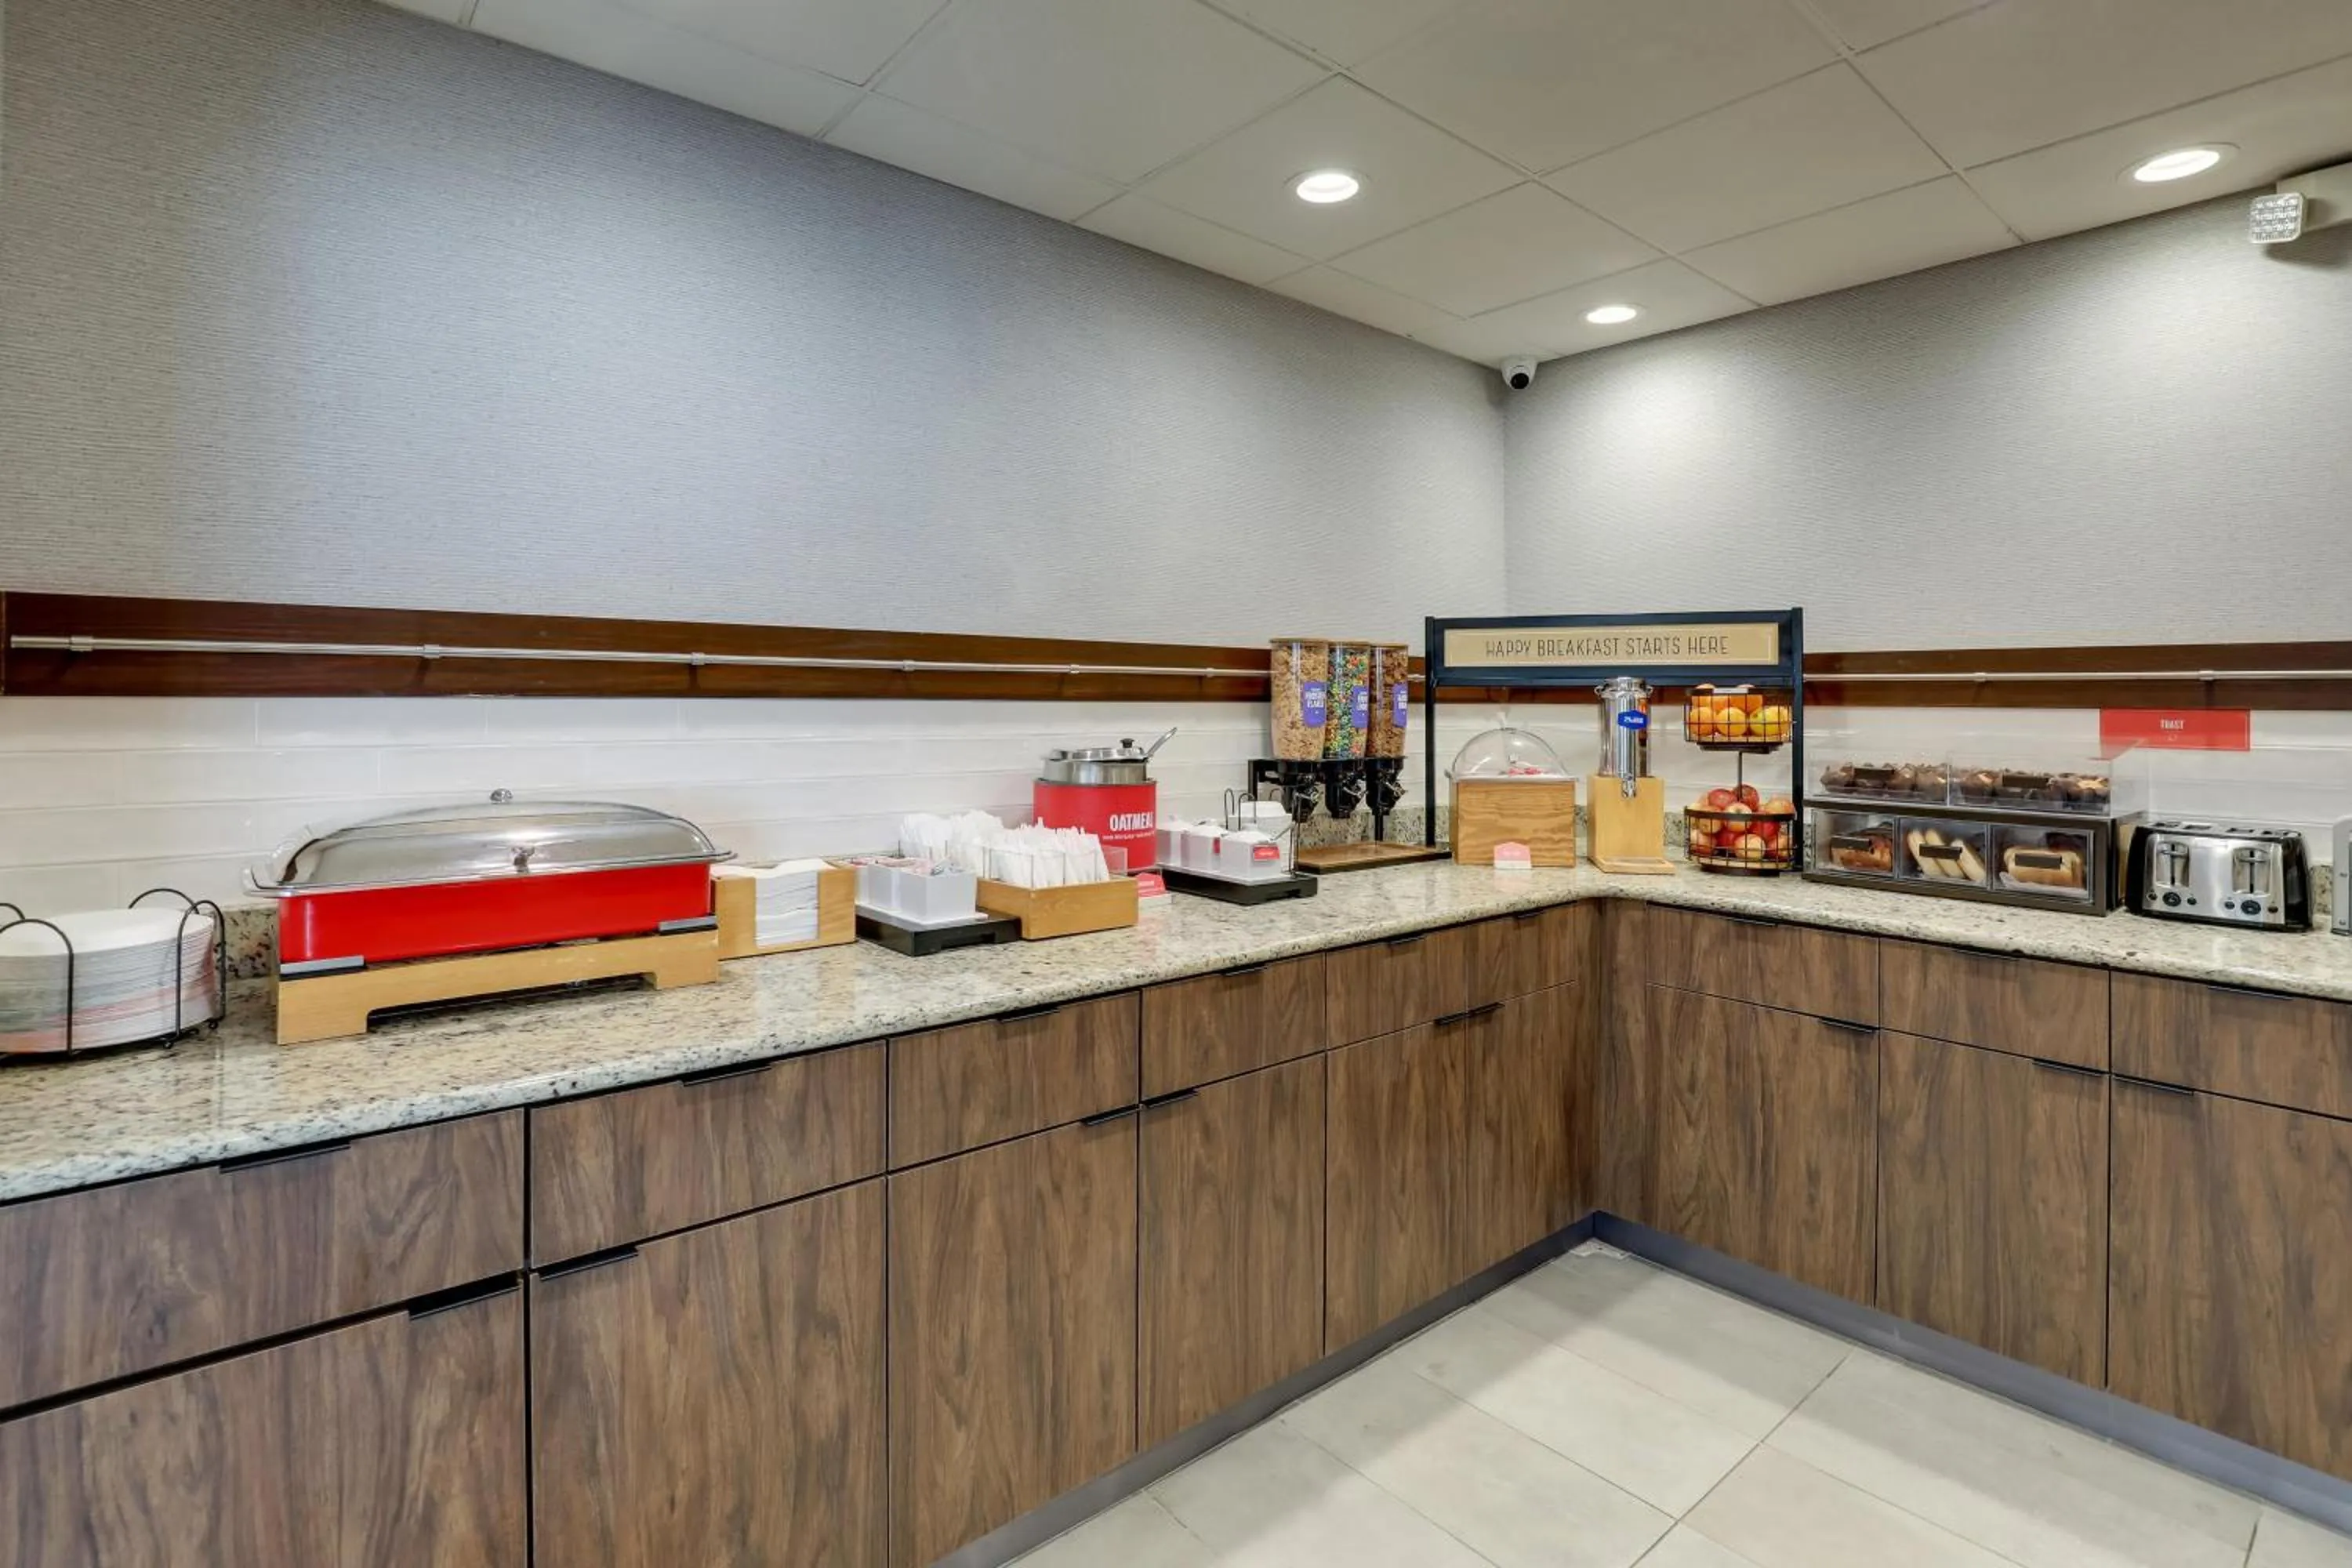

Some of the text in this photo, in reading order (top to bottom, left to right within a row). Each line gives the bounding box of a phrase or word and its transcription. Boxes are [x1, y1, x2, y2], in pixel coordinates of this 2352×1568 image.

[1486, 636, 1730, 657] HAPPY BREAKFAST STARTS HERE
